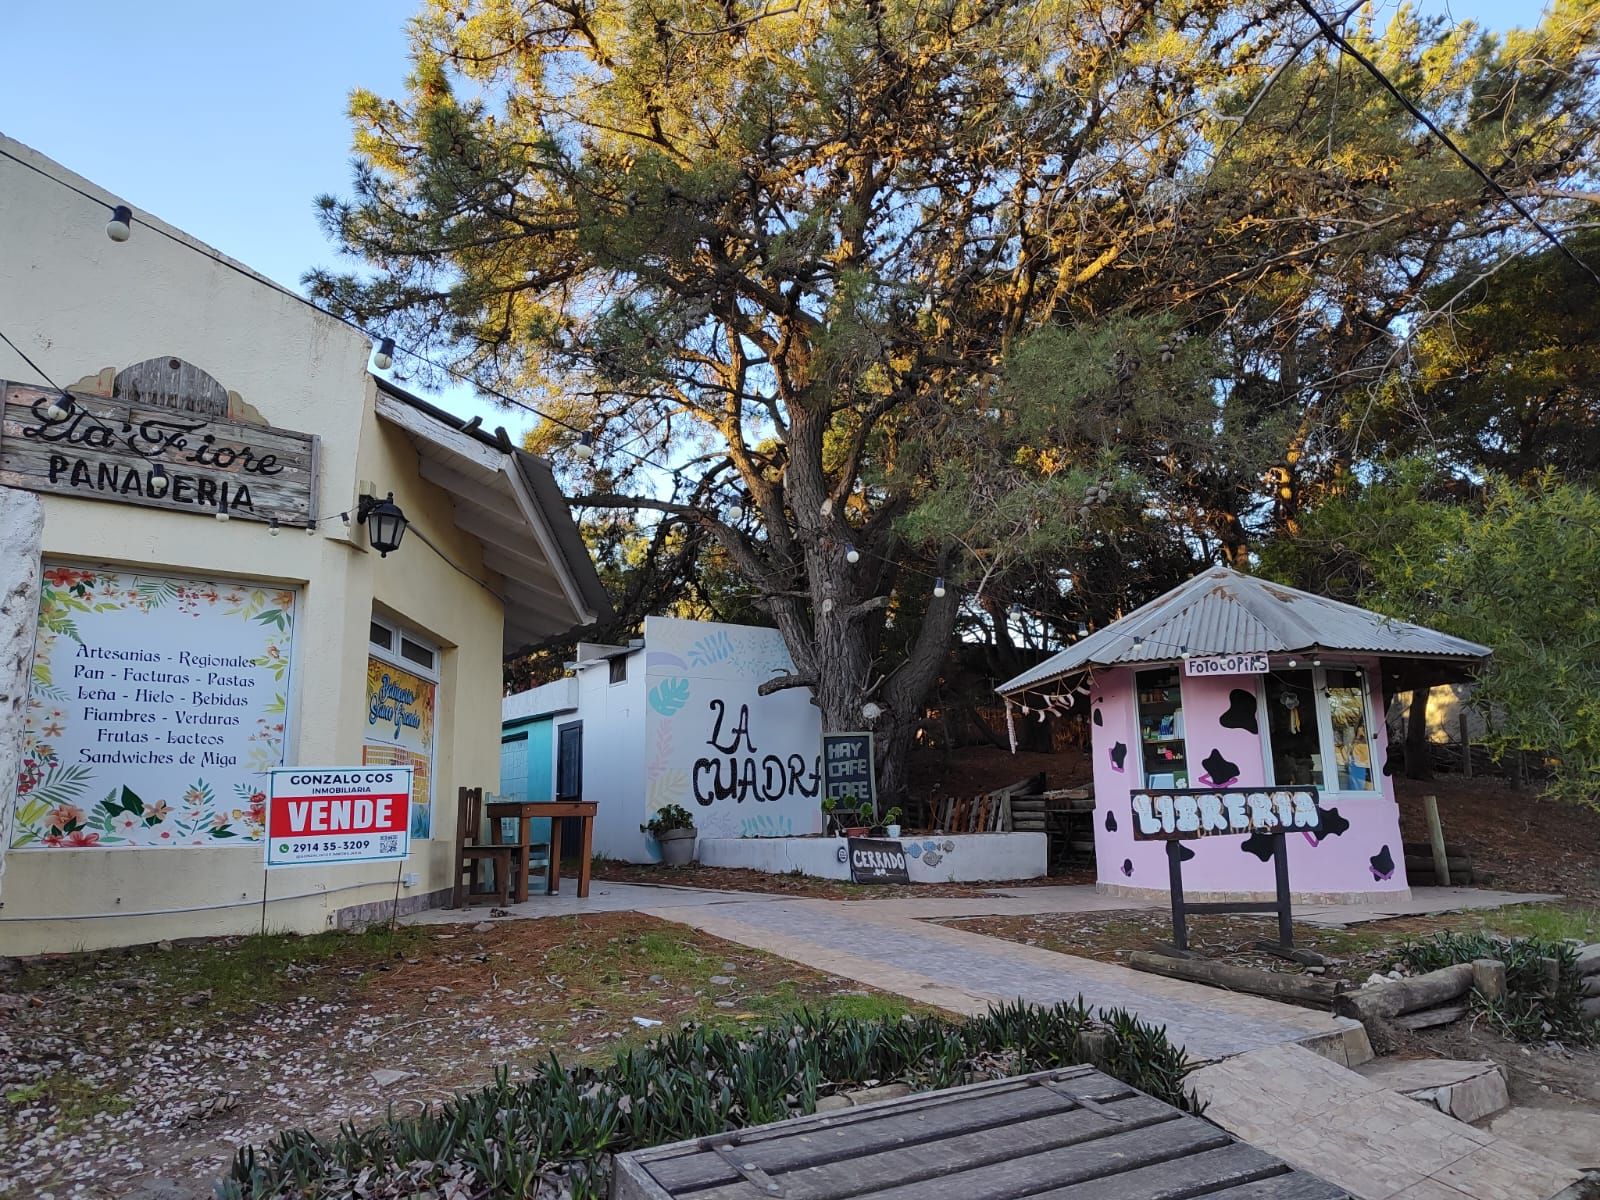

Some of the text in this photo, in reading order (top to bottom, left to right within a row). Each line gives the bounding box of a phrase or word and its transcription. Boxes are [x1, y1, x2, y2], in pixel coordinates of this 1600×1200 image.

[128, 420, 284, 475] Fiore
[49, 454, 255, 512] PANADERIA
[76, 644, 161, 662] Artesanias
[179, 651, 256, 668] Regionales
[74, 665, 104, 679] Pan
[123, 668, 190, 684] Facturas
[208, 673, 255, 688] Pastas
[78, 686, 116, 701] Leña
[135, 689, 174, 703] Hielo
[192, 692, 248, 707] Bebidas
[84, 707, 156, 723] Fiambres
[175, 711, 240, 726] Verduras
[97, 729, 149, 743] Frutas
[167, 731, 224, 745] Lacteos
[706, 699, 758, 755] LA
[78, 749, 237, 768] Sandwiches de Miga
[828, 742, 863, 760] HAY
[828, 759, 867, 777] CAFE
[290, 773, 393, 785] GONZALO COS
[312, 786, 371, 794] INMOBILIARIA
[828, 781, 870, 801] CAFE
[288, 799, 393, 832] VENDE
[1132, 791, 1319, 834] LIBRERIA
[293, 840, 370, 853] 2914 35-3209
[853, 849, 905, 870] CERRADO
